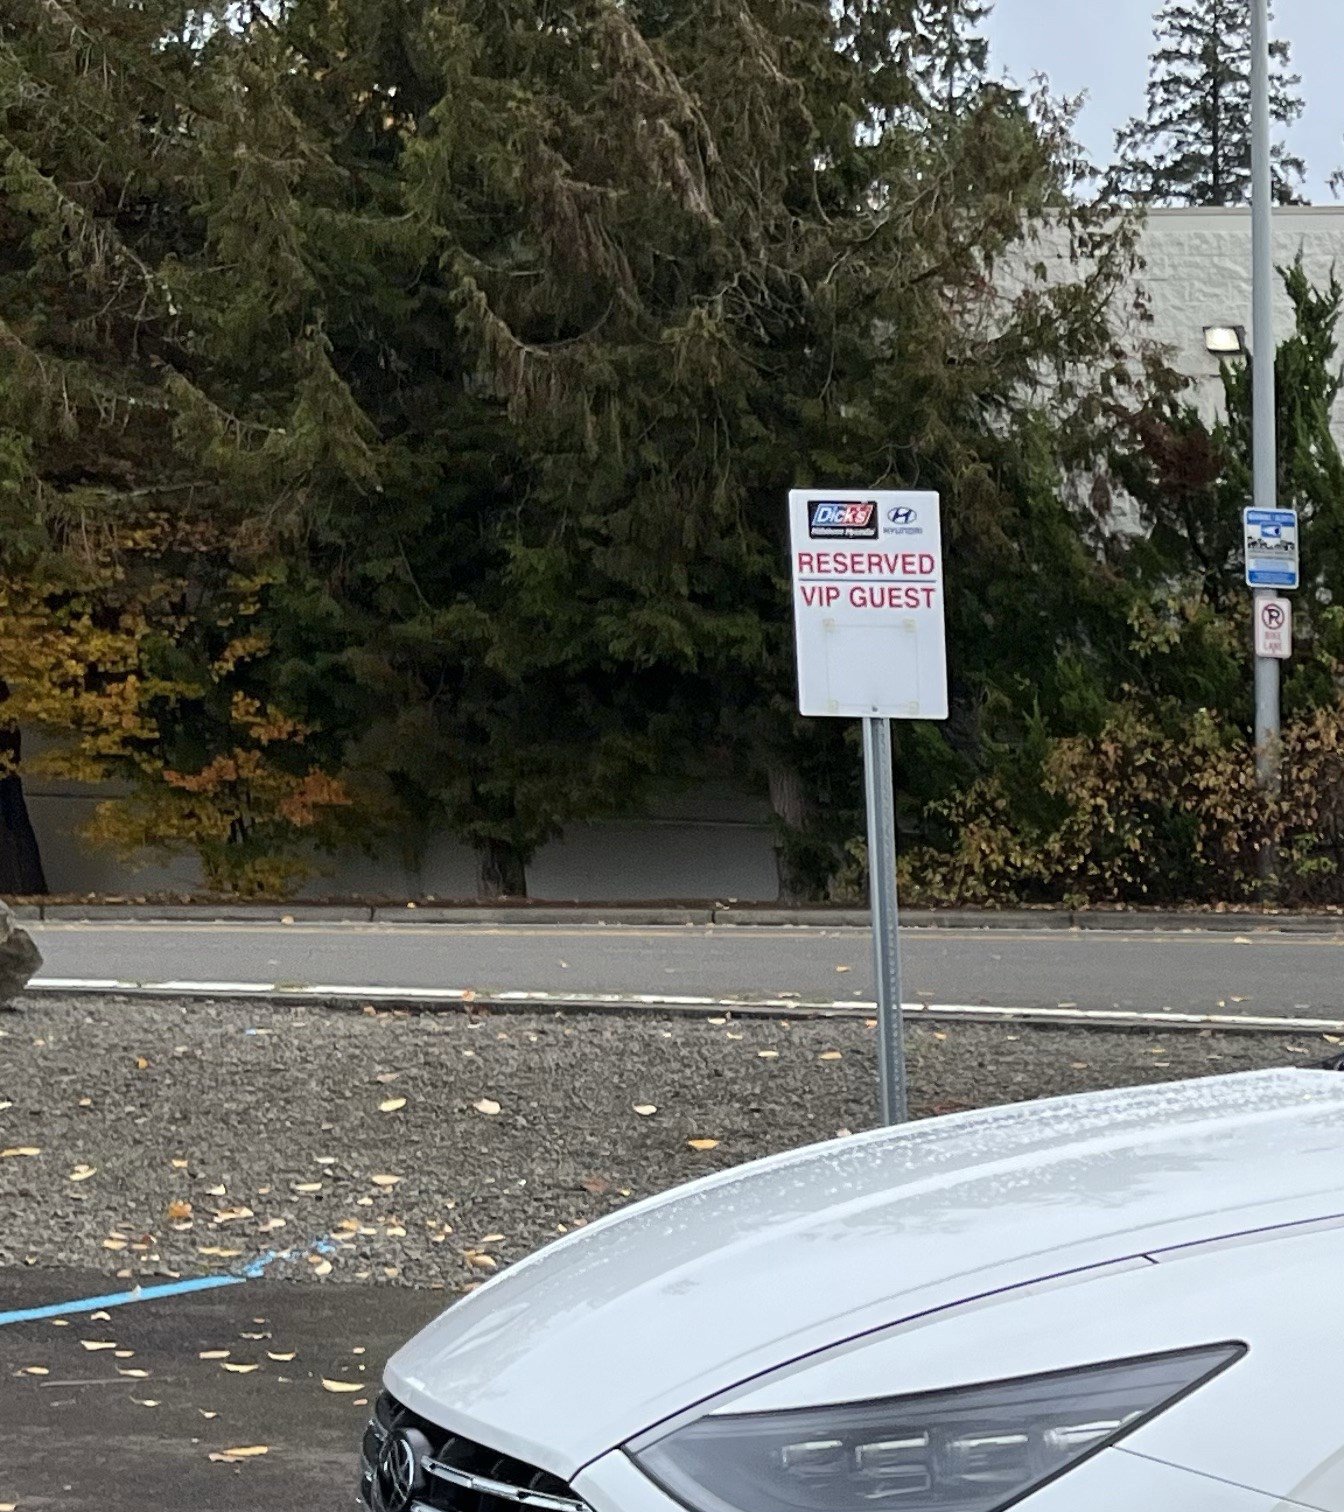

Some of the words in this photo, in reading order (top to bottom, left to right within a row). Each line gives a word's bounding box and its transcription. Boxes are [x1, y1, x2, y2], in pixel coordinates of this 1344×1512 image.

[798, 552, 935, 575] RESERVED
[800, 586, 840, 606] VIP
[850, 587, 936, 609] GUEST
